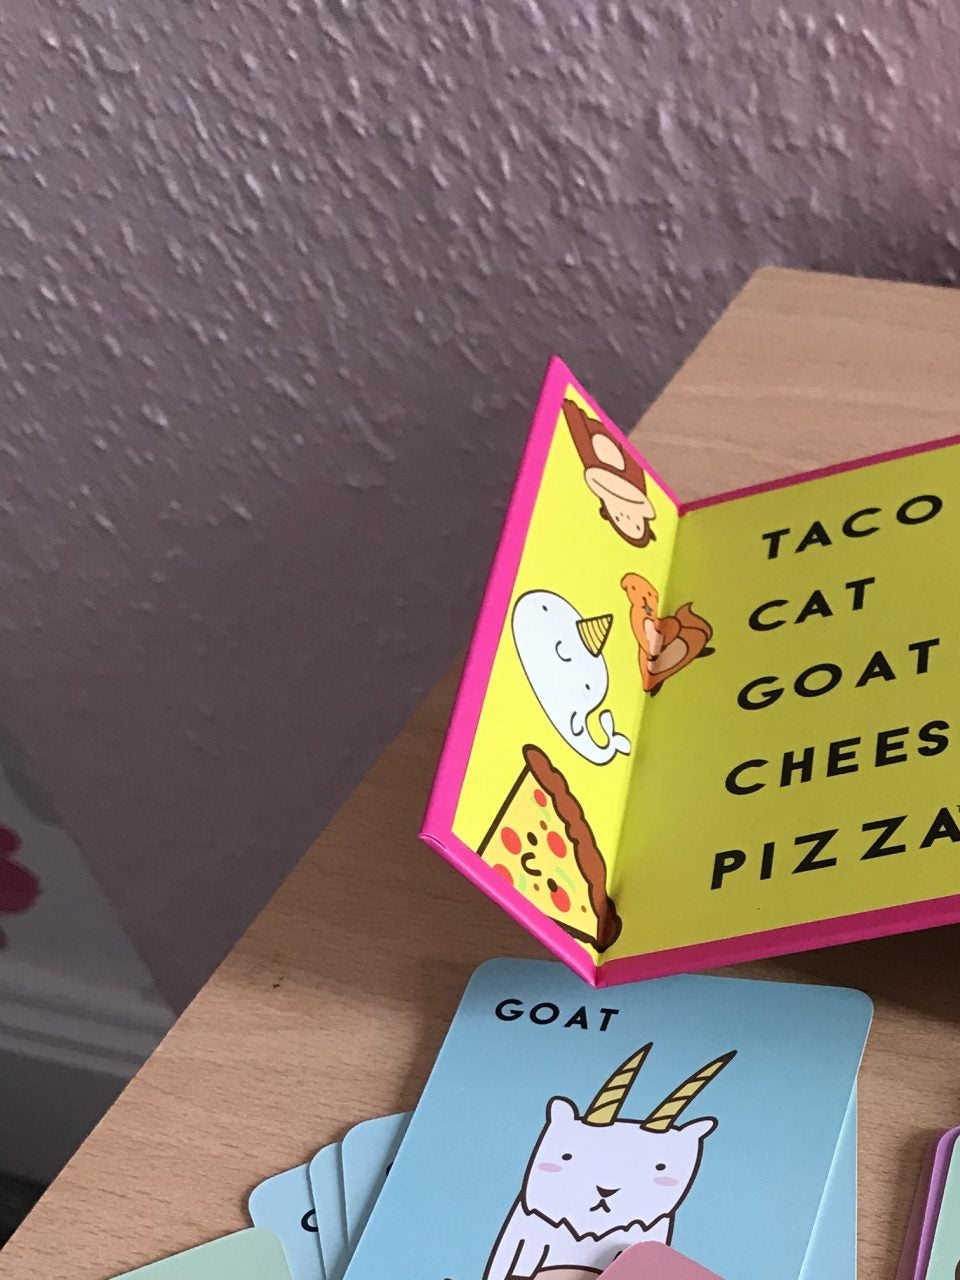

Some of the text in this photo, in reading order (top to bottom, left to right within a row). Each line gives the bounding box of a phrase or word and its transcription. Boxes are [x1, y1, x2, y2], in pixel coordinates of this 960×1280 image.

[762, 495, 942, 559] TACO
[749, 577, 875, 631] CAT
[738, 638, 939, 710] GOAT
[495, 999, 619, 1031] GOAT
